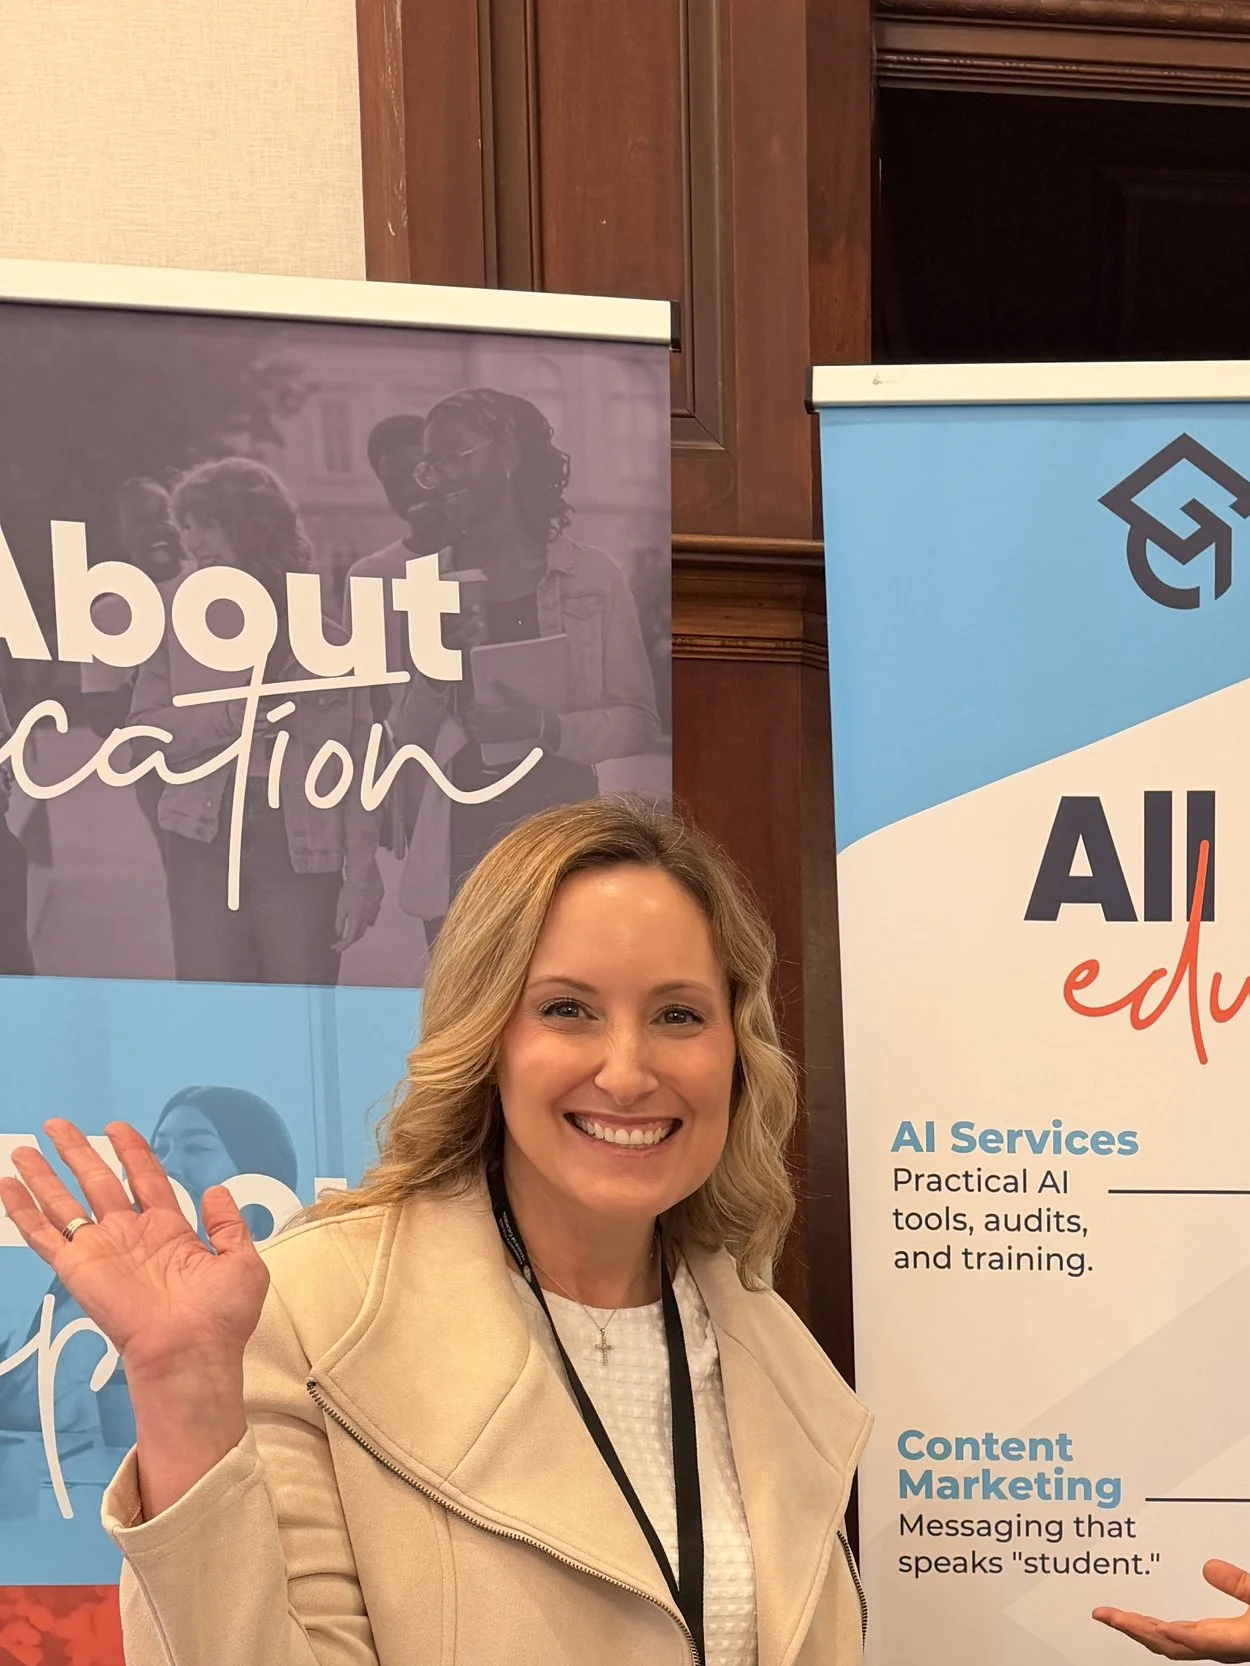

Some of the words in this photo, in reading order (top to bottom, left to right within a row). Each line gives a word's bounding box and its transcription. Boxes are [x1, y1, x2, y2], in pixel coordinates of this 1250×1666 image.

[0, 655, 544, 911] cation
[1024, 791, 1215, 922] All
[891, 1120, 936, 1154] AI
[951, 1118, 1140, 1157] Services
[892, 1167, 1028, 1194] Practical
[1037, 1170, 1069, 1194] AI
[892, 1206, 975, 1237] tools,
[983, 1207, 1089, 1238] audits,
[893, 1245, 952, 1271] and
[961, 1245, 1095, 1278] training.
[896, 1429, 1074, 1463] Content
[897, 1467, 1123, 1509] Marketing
[898, 1513, 1065, 1544] Messaging
[1073, 1514, 1138, 1539] that
[898, 1550, 1004, 1579] speaks
[1012, 1551, 1161, 1576] "student."
